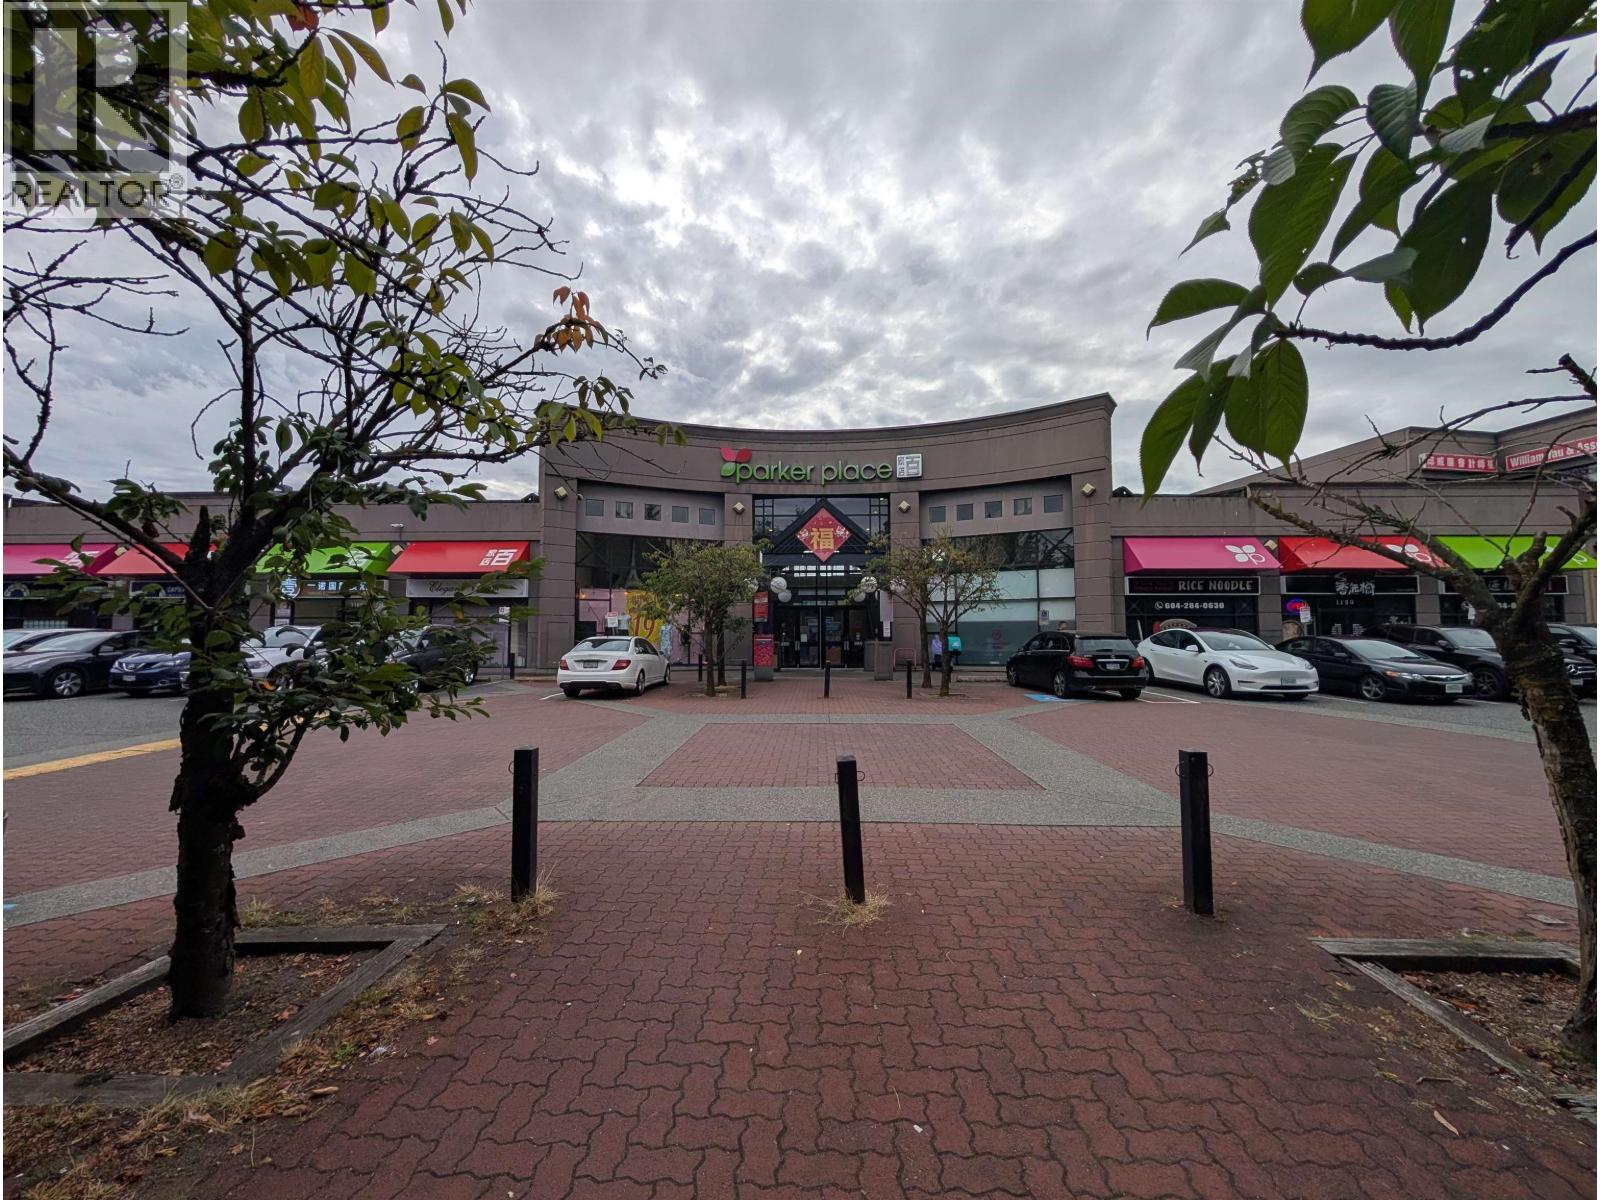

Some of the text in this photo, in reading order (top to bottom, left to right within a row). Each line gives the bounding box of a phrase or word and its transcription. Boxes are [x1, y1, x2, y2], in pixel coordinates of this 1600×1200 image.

[1510, 453, 1544, 467] William
[1577, 441, 1597, 453] Ass
[736, 460, 893, 487] parker place
[810, 528, 834, 550] 福
[1178, 580, 1204, 591] RICE
[1209, 580, 1253, 591] NOODLE
